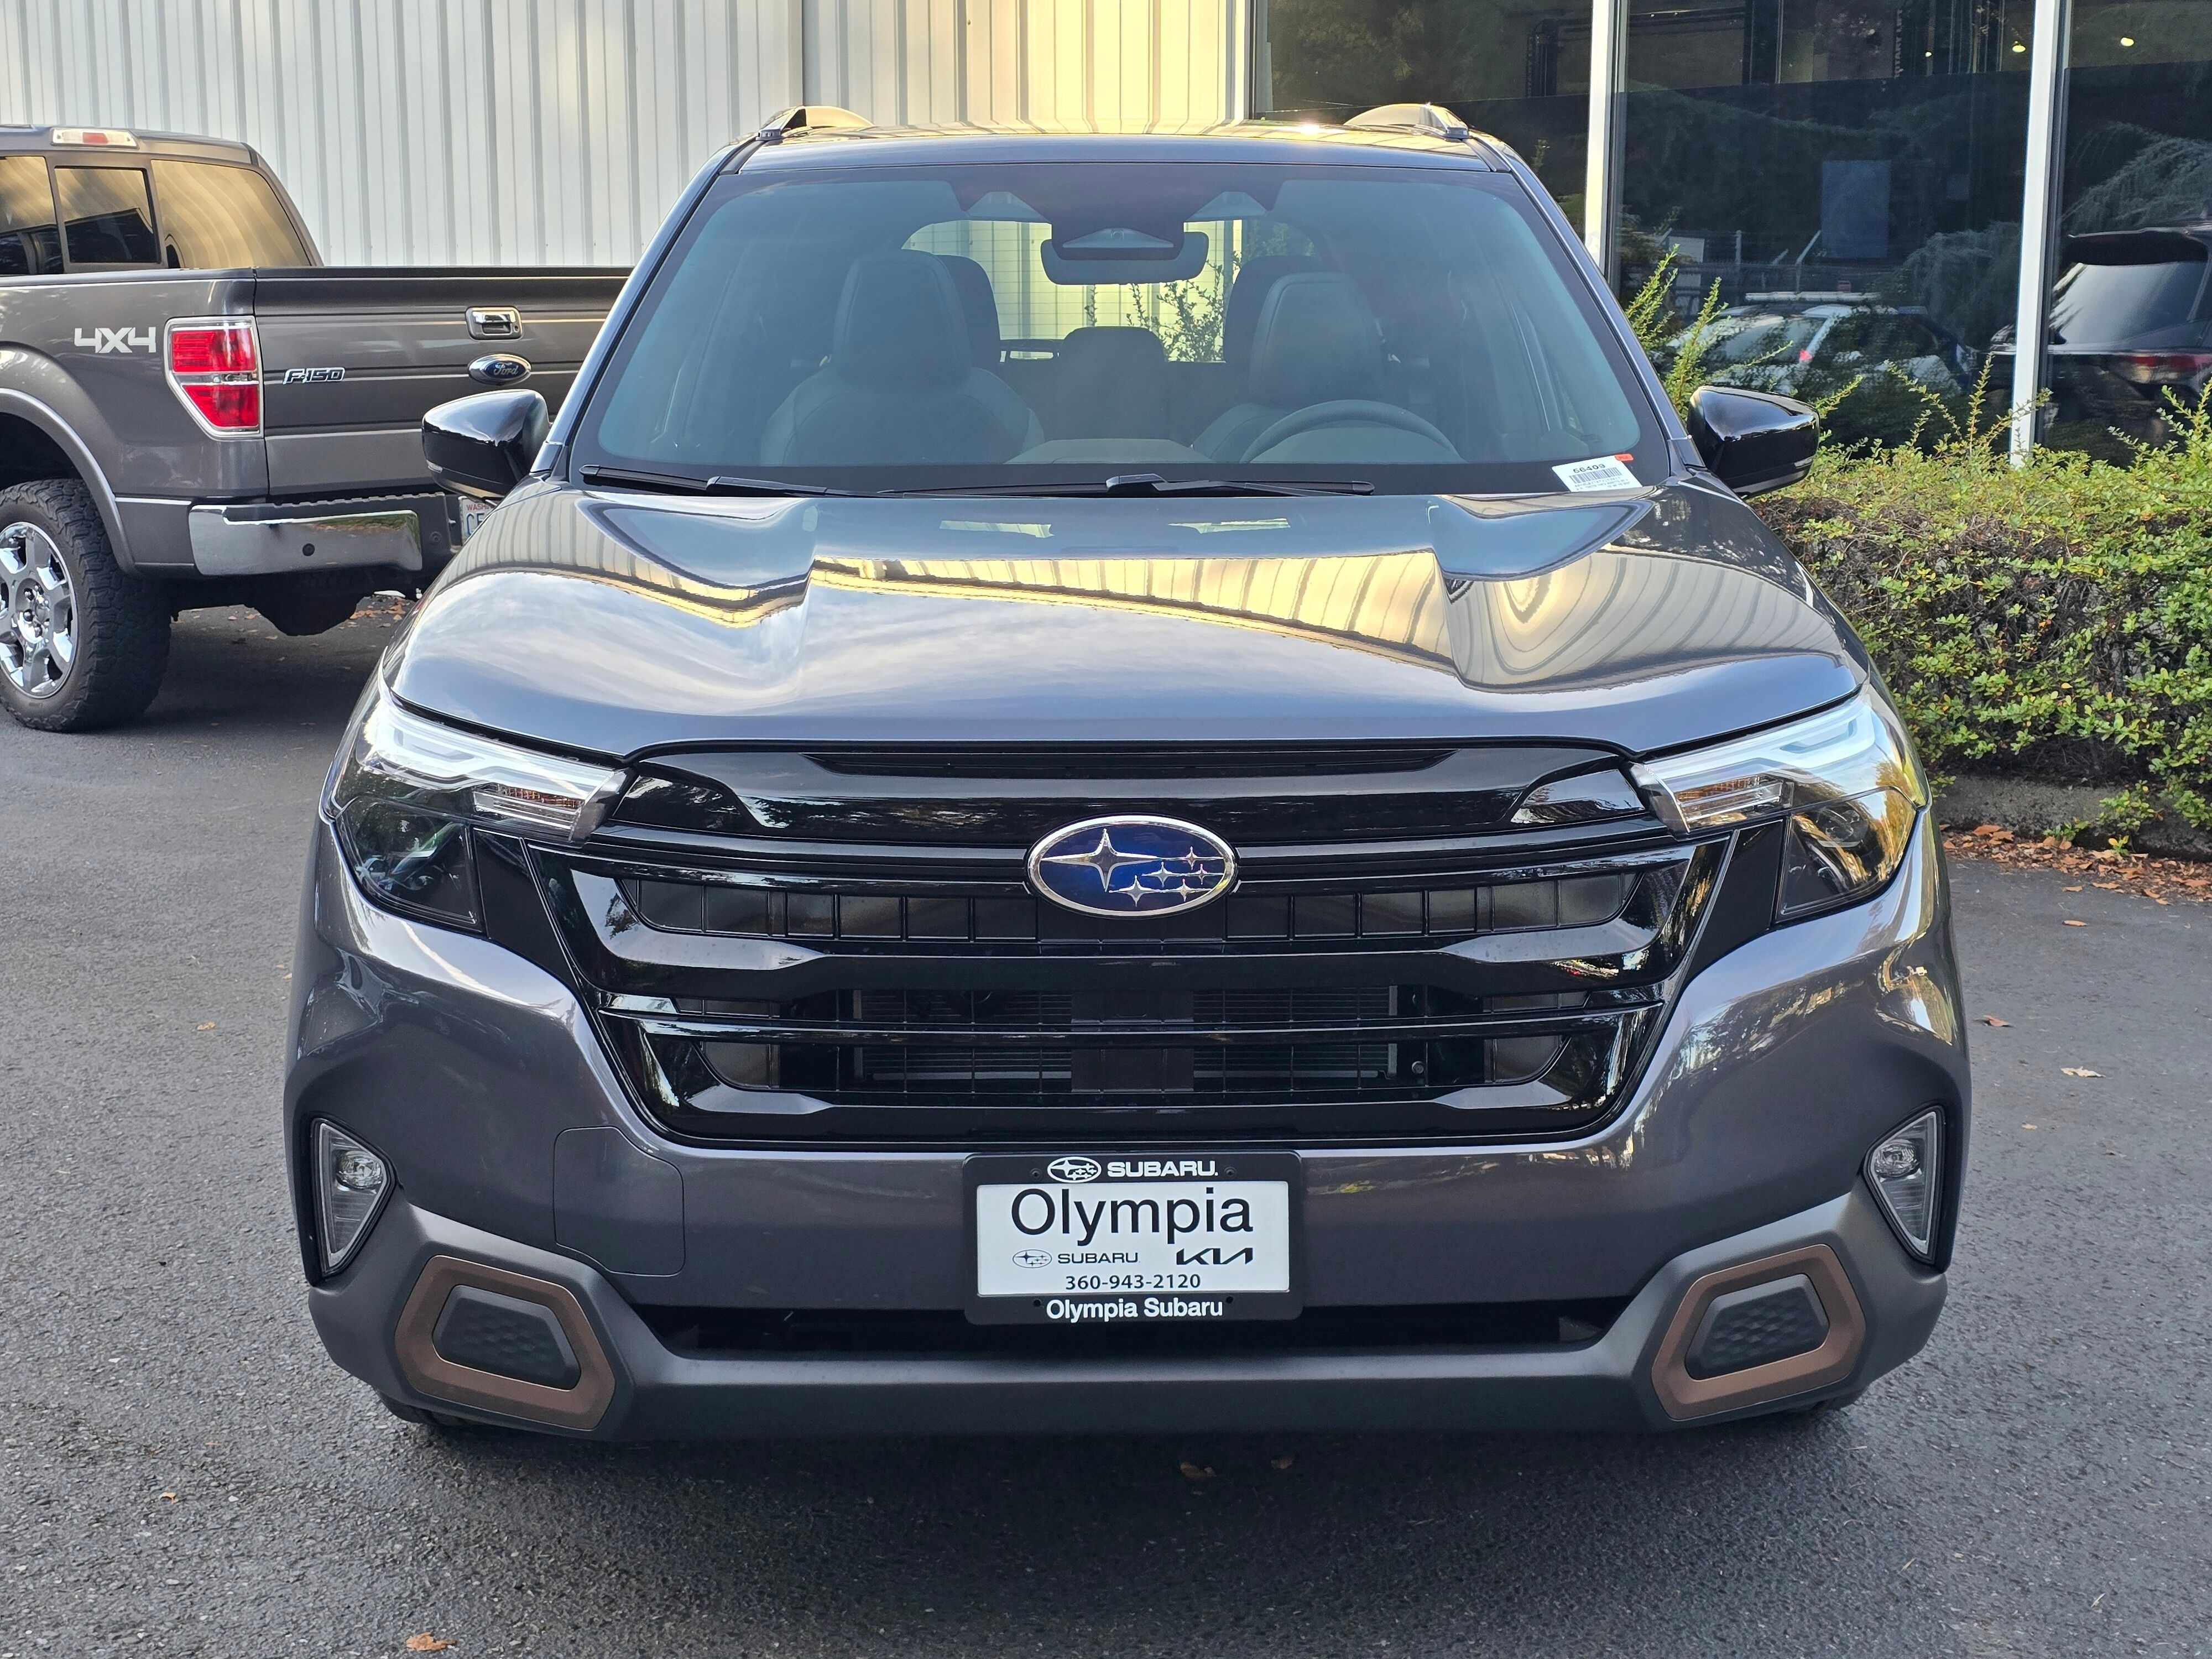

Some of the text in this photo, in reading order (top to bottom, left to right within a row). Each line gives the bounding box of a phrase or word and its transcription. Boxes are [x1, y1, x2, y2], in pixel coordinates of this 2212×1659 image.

[283, 367, 346, 385] F-150
[493, 362, 519, 375] Ford
[1011, 1187, 1253, 1246] Olympia
[1057, 1252, 1139, 1264] SUBARU
[1065, 1274, 1201, 1290] 360-943-2120
[1046, 1297, 1223, 1323] Olympia Subaru
